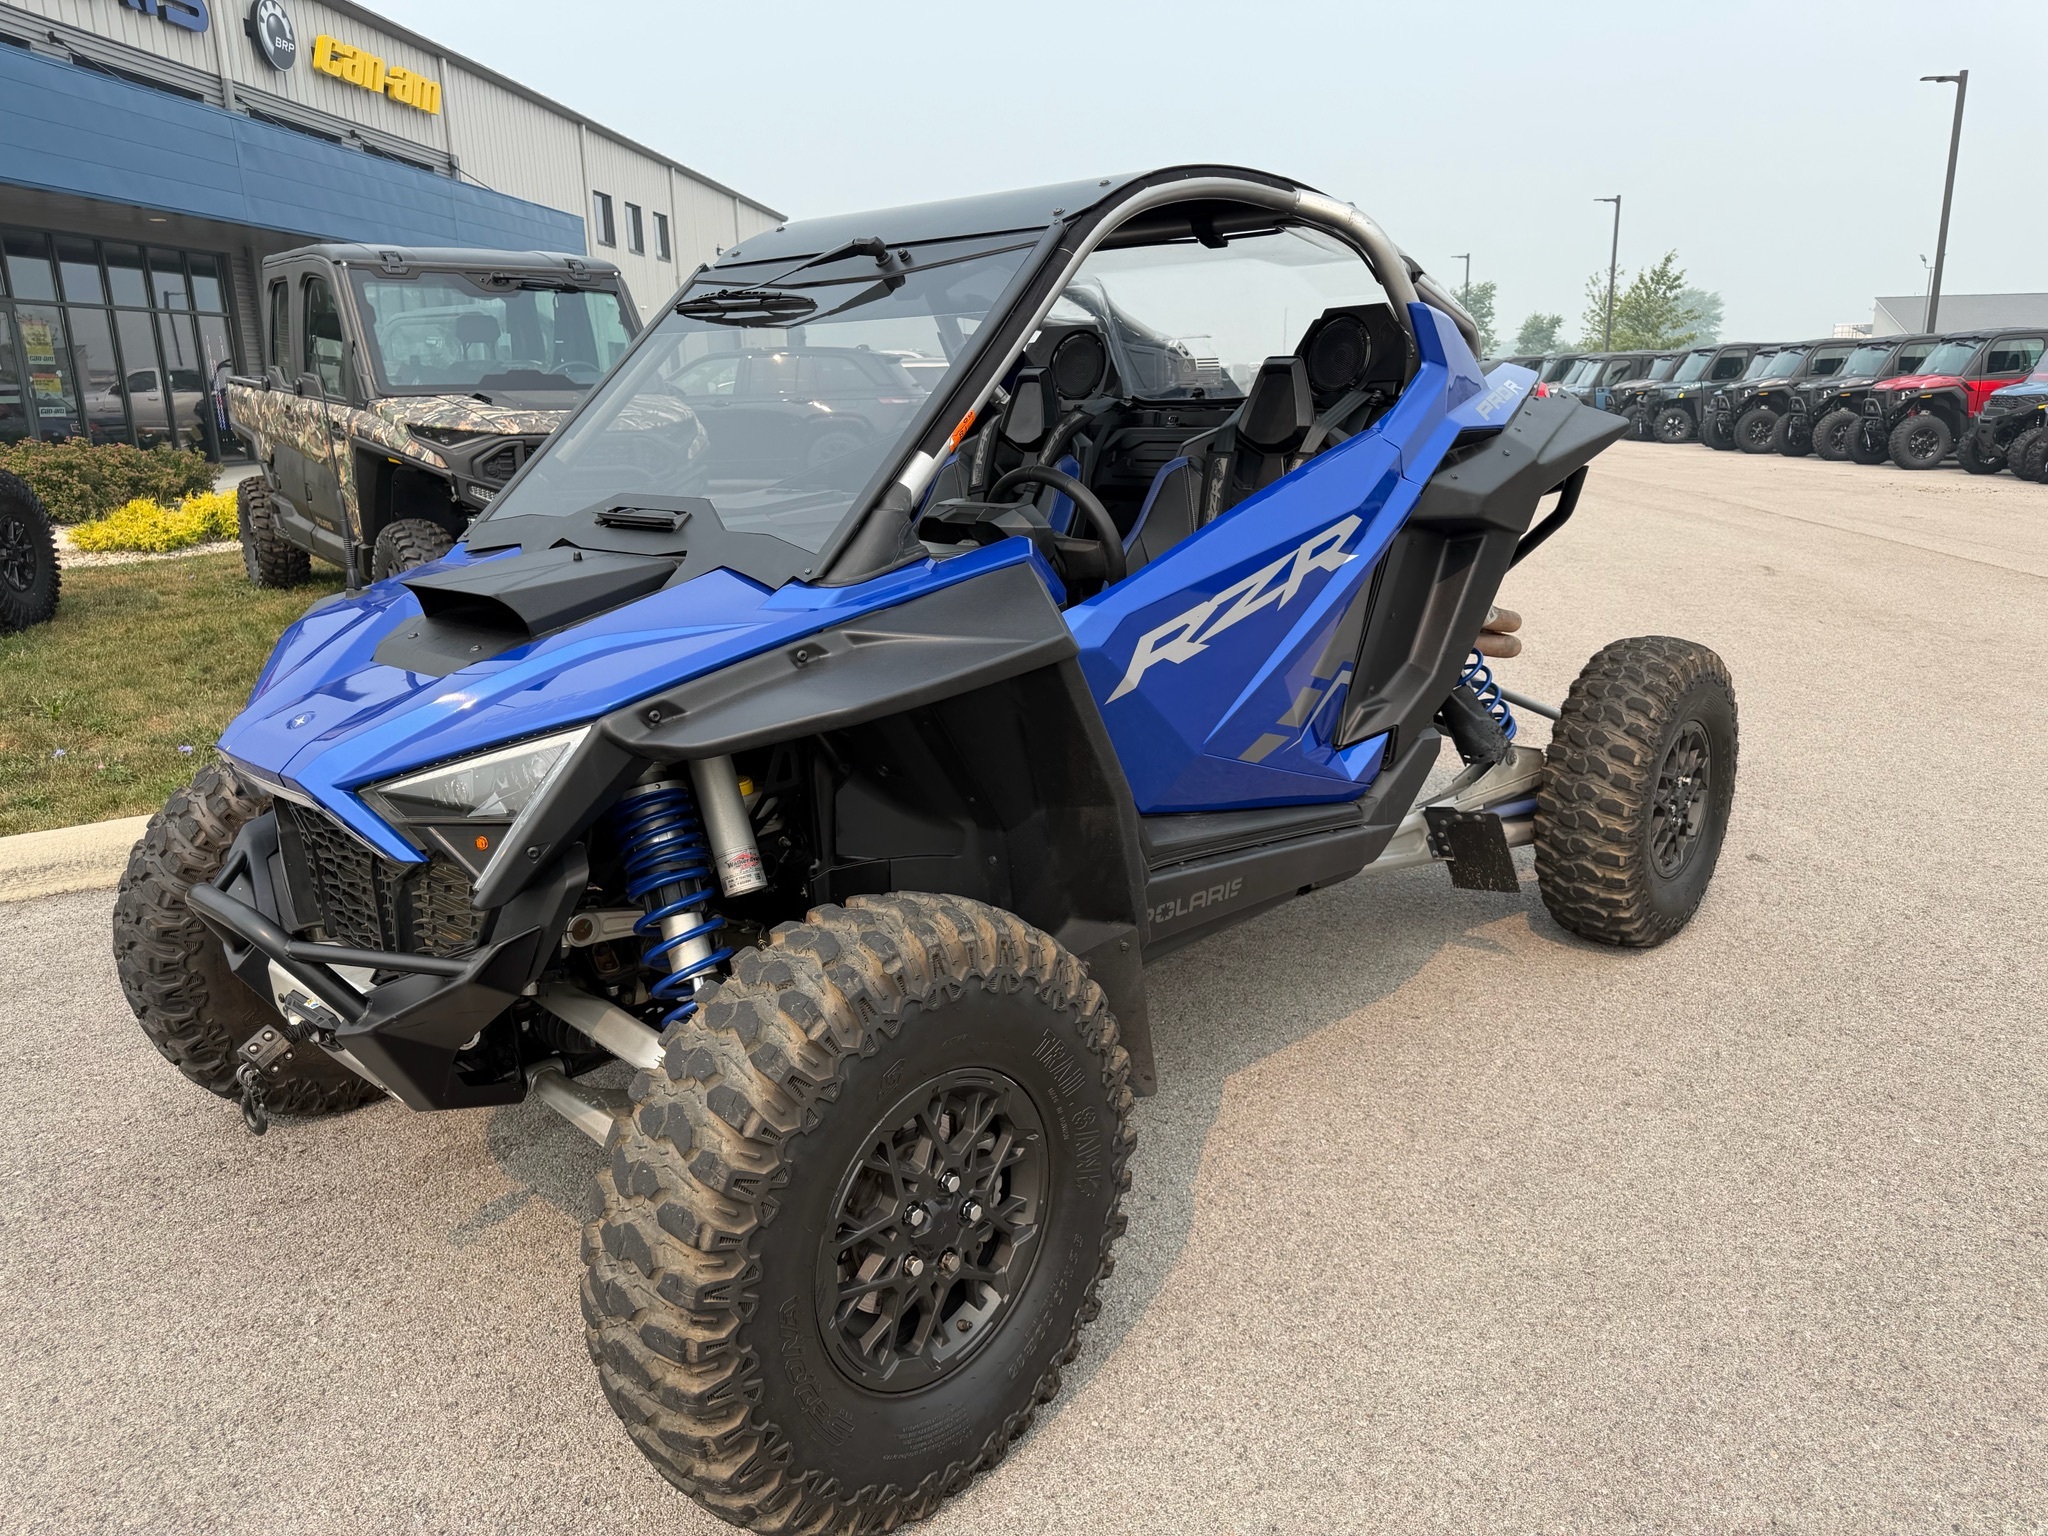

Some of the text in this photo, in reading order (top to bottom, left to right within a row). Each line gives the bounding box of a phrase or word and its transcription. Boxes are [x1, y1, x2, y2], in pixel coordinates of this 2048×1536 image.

[275, 36, 295, 52] BRP
[312, 34, 441, 115] can-am
[1104, 514, 1362, 705] RZR
